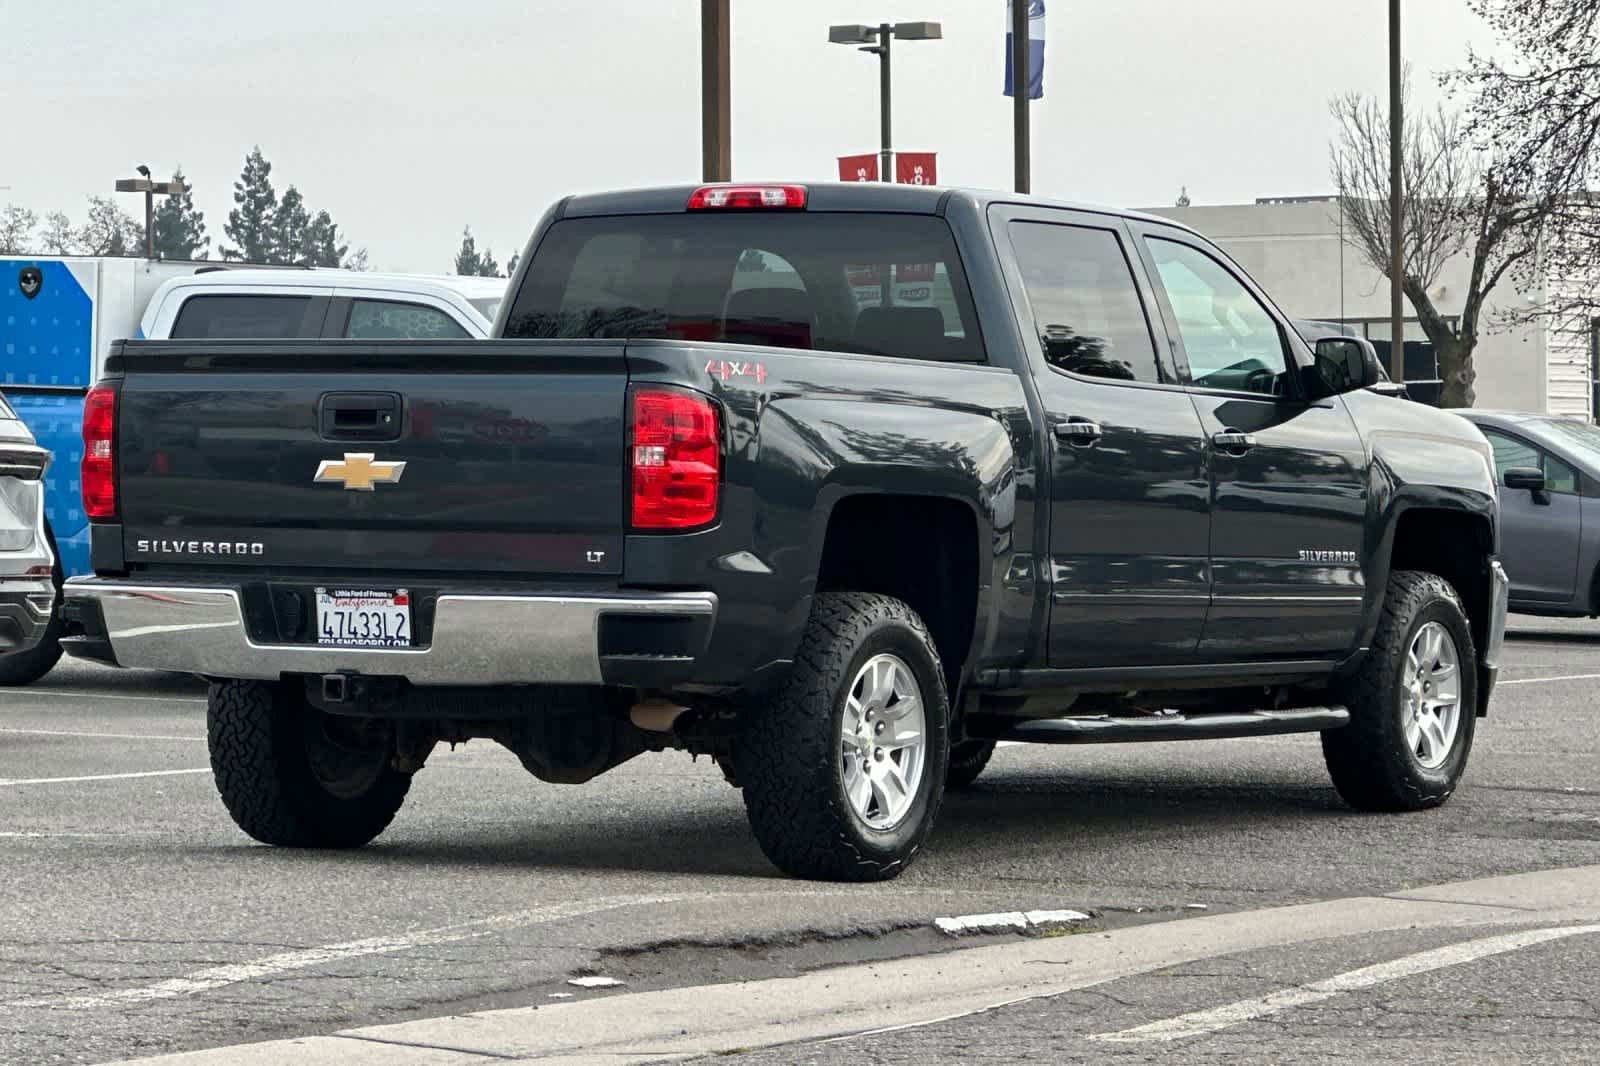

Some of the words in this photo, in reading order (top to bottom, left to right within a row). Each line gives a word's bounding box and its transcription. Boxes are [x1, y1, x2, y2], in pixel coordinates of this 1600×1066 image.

[137, 540, 264, 555] SILVERADO
[586, 551, 605, 562] LT
[1298, 550, 1356, 562] SILVERADO
[320, 595, 332, 604] JUL
[335, 590, 350, 598] Lithia
[351, 590, 363, 598] Ford
[335, 598, 389, 611] California
[323, 611, 407, 640] 47433L2
